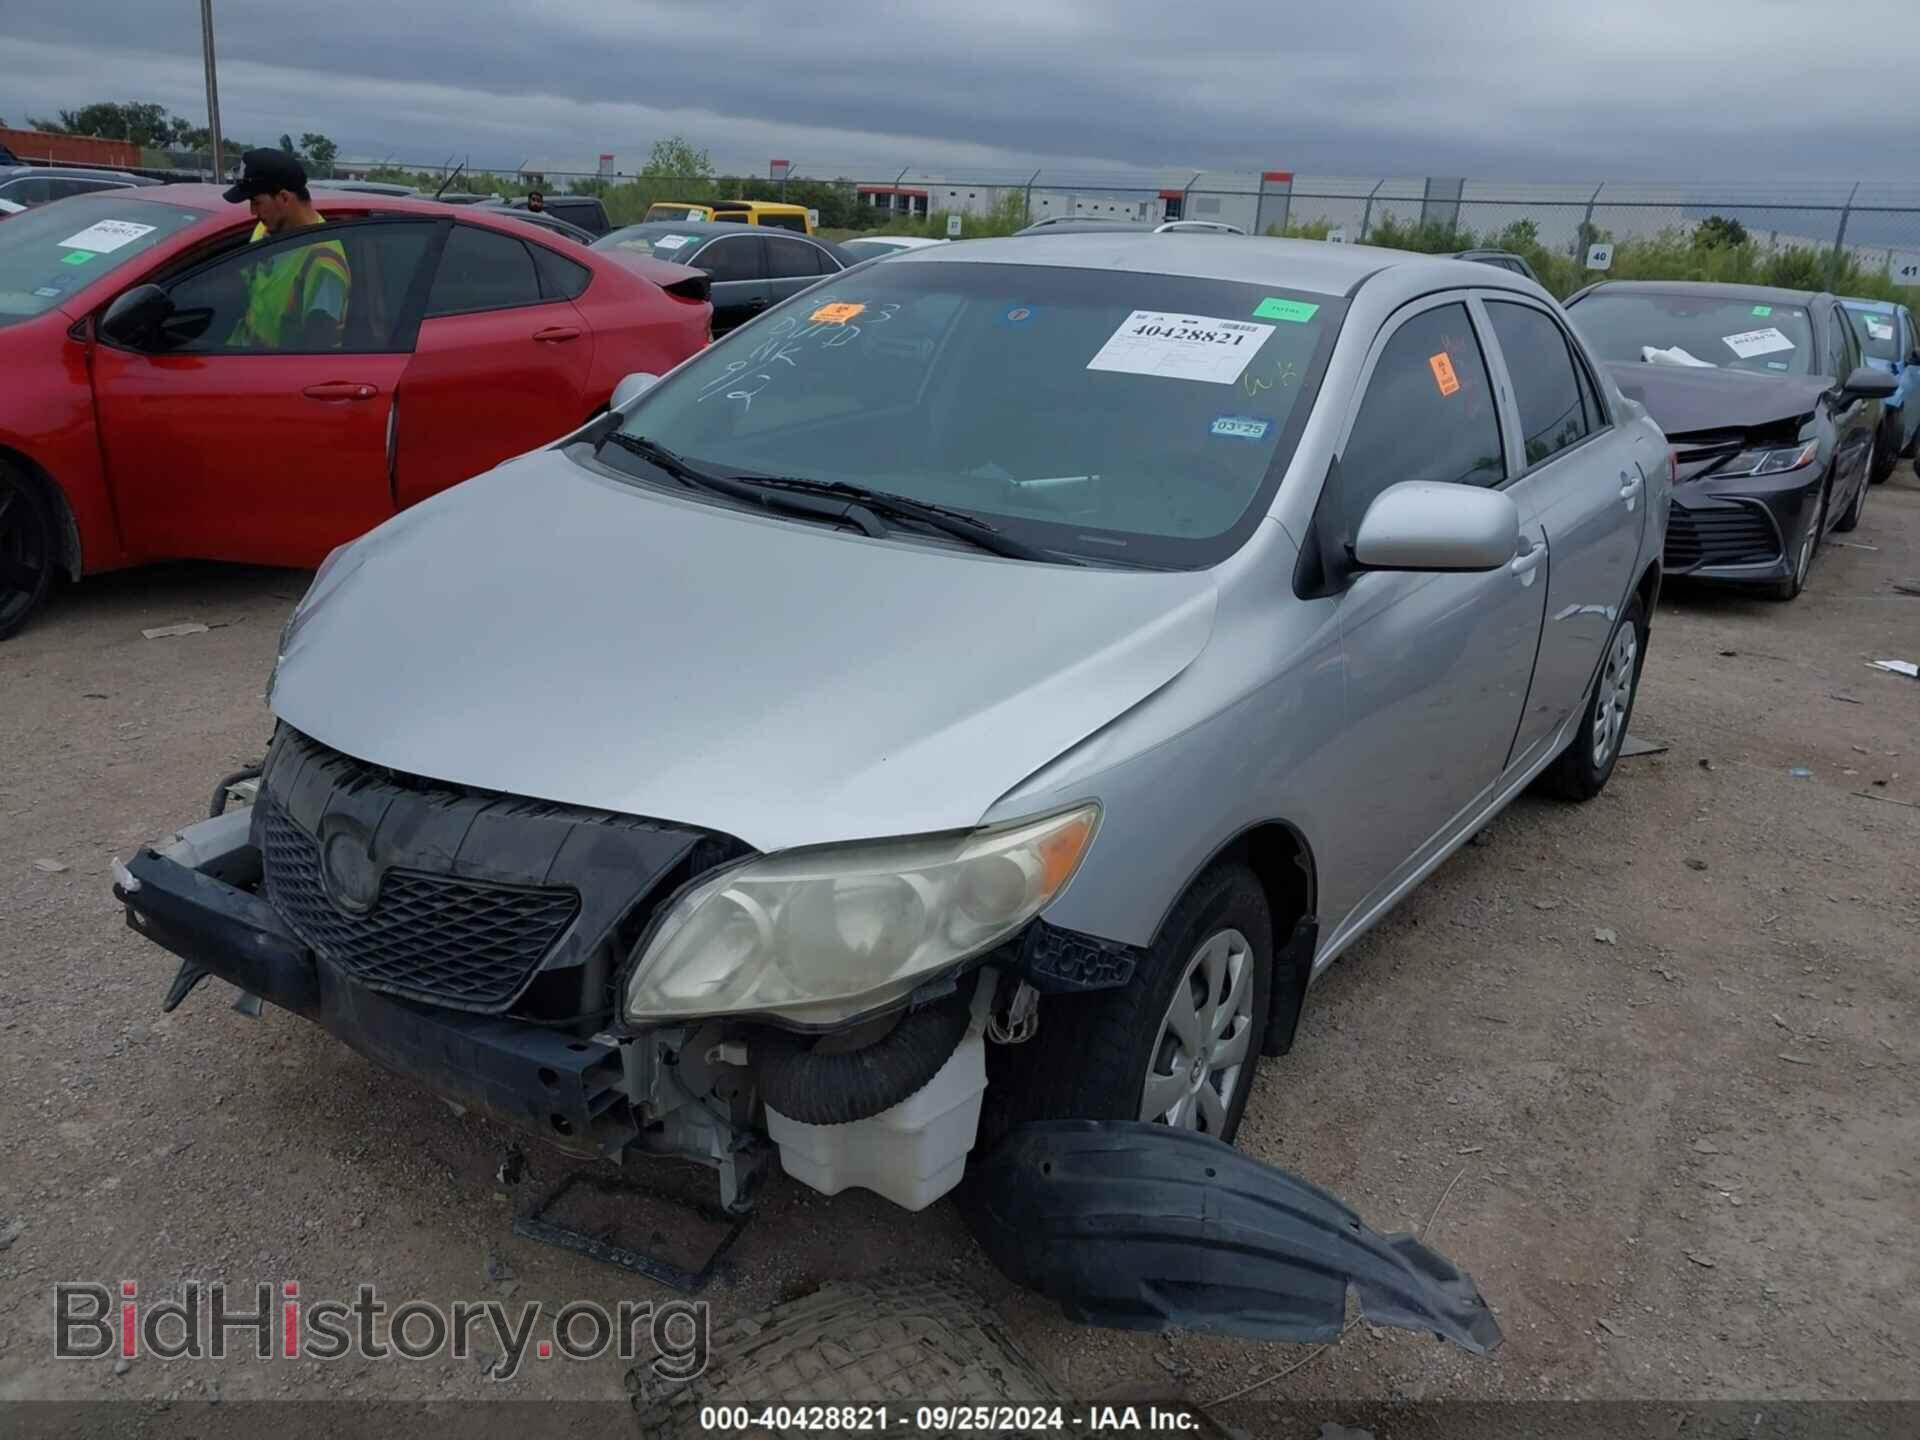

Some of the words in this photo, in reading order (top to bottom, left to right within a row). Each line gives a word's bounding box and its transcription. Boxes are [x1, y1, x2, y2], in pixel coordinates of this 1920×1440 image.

[1593, 251, 1607, 261] 40
[1901, 266, 1918, 277] 41
[1132, 324, 1245, 346] 40428821
[1217, 421, 1235, 431] 03
[1243, 423, 1262, 434] 25
